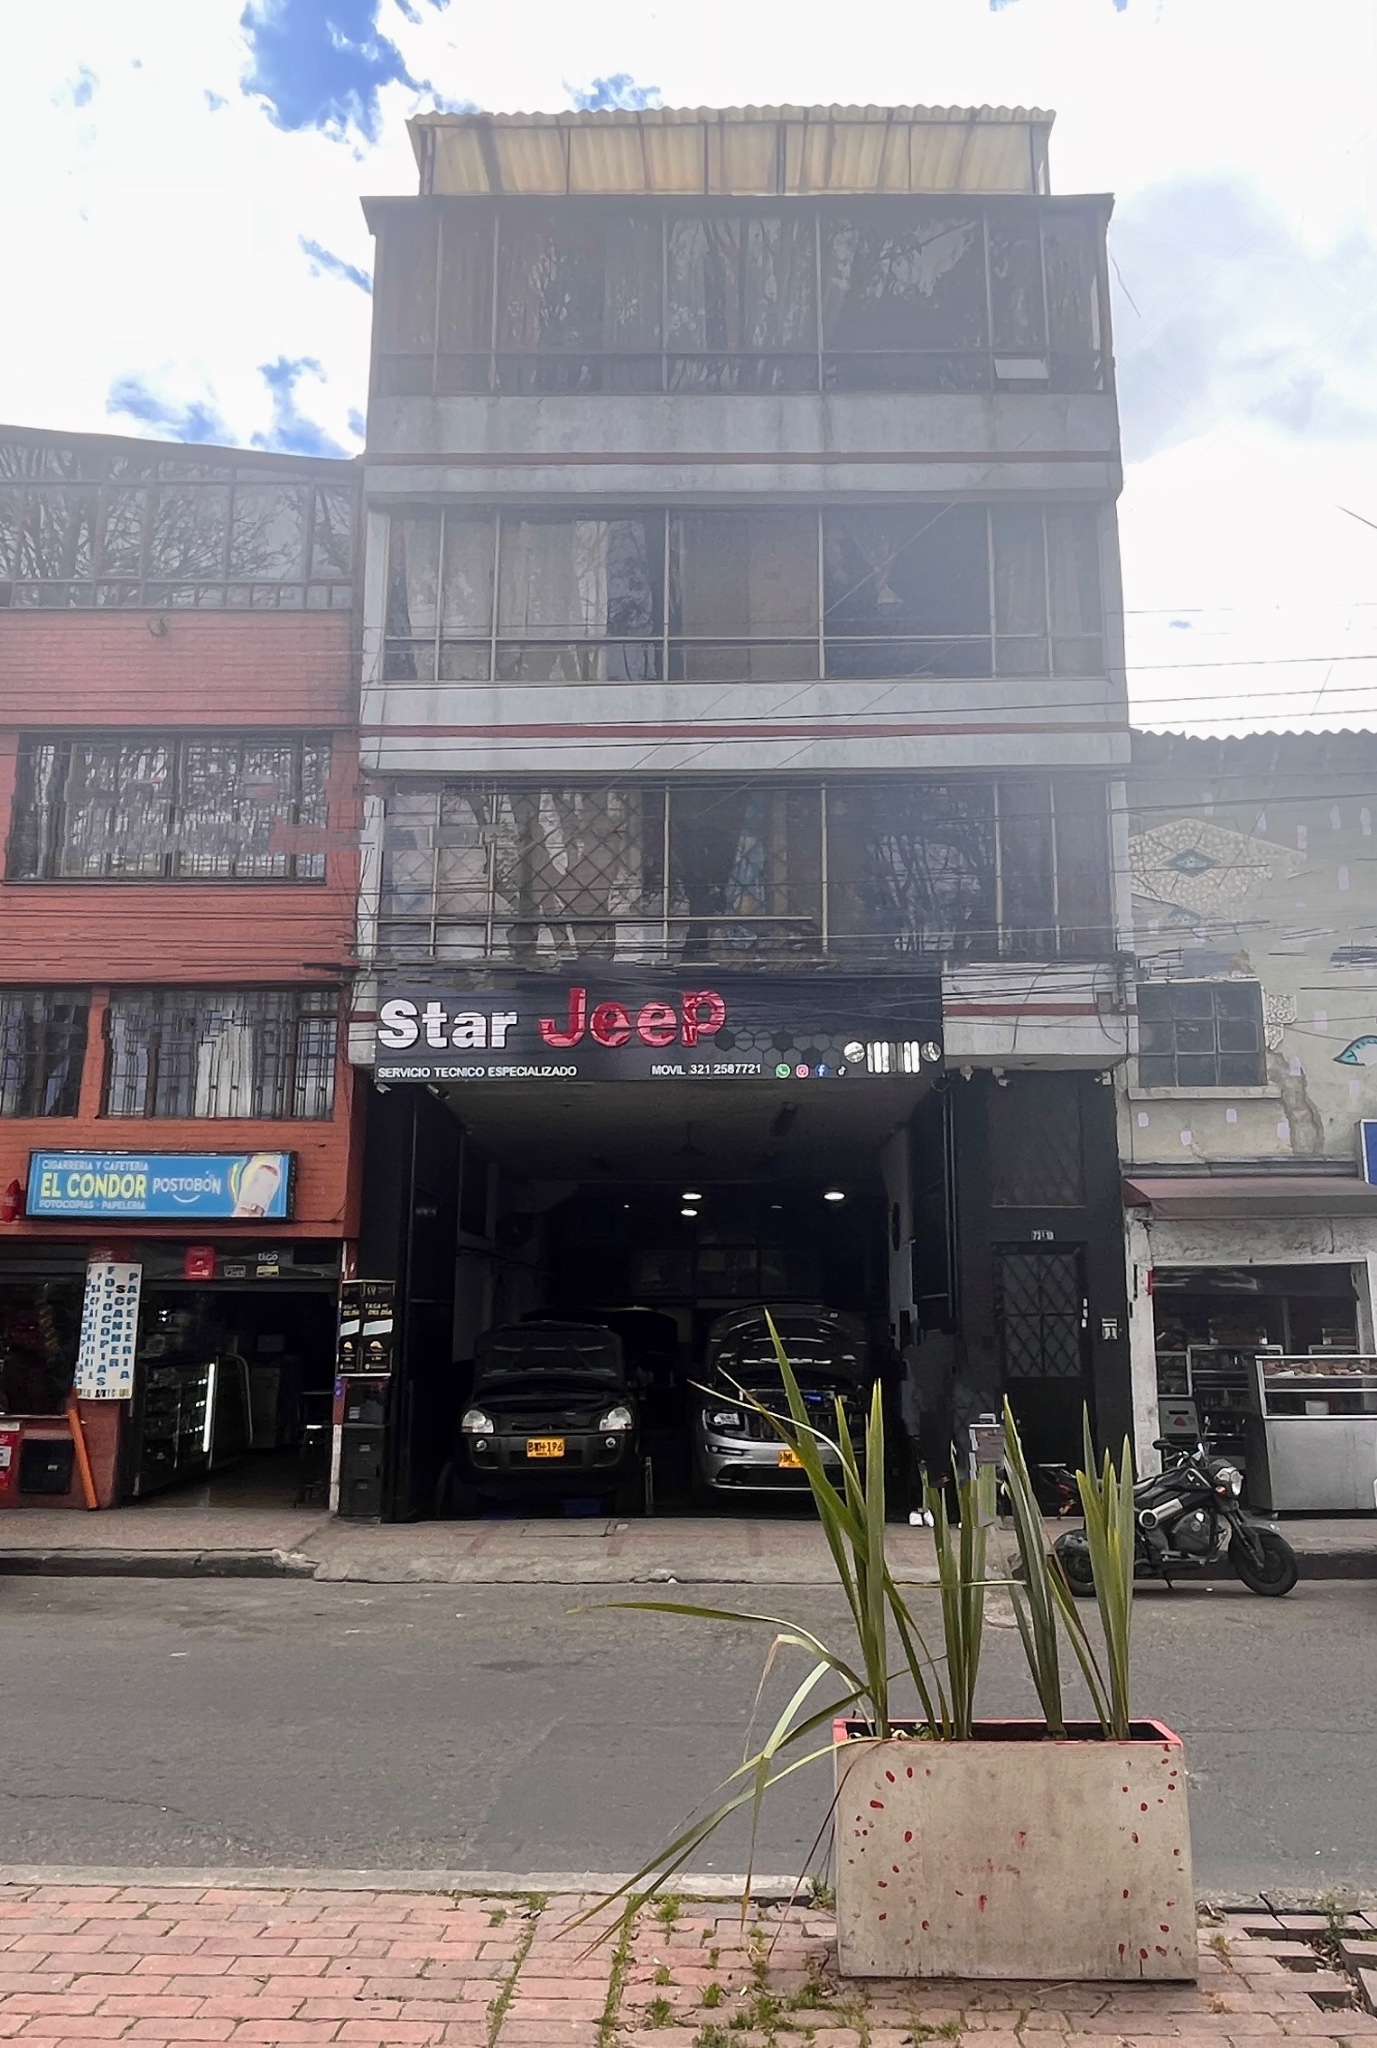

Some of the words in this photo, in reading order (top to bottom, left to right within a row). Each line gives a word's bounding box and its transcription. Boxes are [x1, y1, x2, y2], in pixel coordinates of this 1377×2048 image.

[377, 998, 518, 1048] Star
[538, 987, 727, 1048] Jeep
[378, 1067, 431, 1078] SERVICIO
[434, 1067, 485, 1077] TECNICO
[488, 1066, 577, 1077] ESPECIALIZADO
[651, 1065, 686, 1075] MOVIL
[689, 1064, 711, 1075] 321
[713, 1064, 761, 1074] 2587721
[41, 1172, 61, 1198] EL
[67, 1173, 147, 1198] CONDOR
